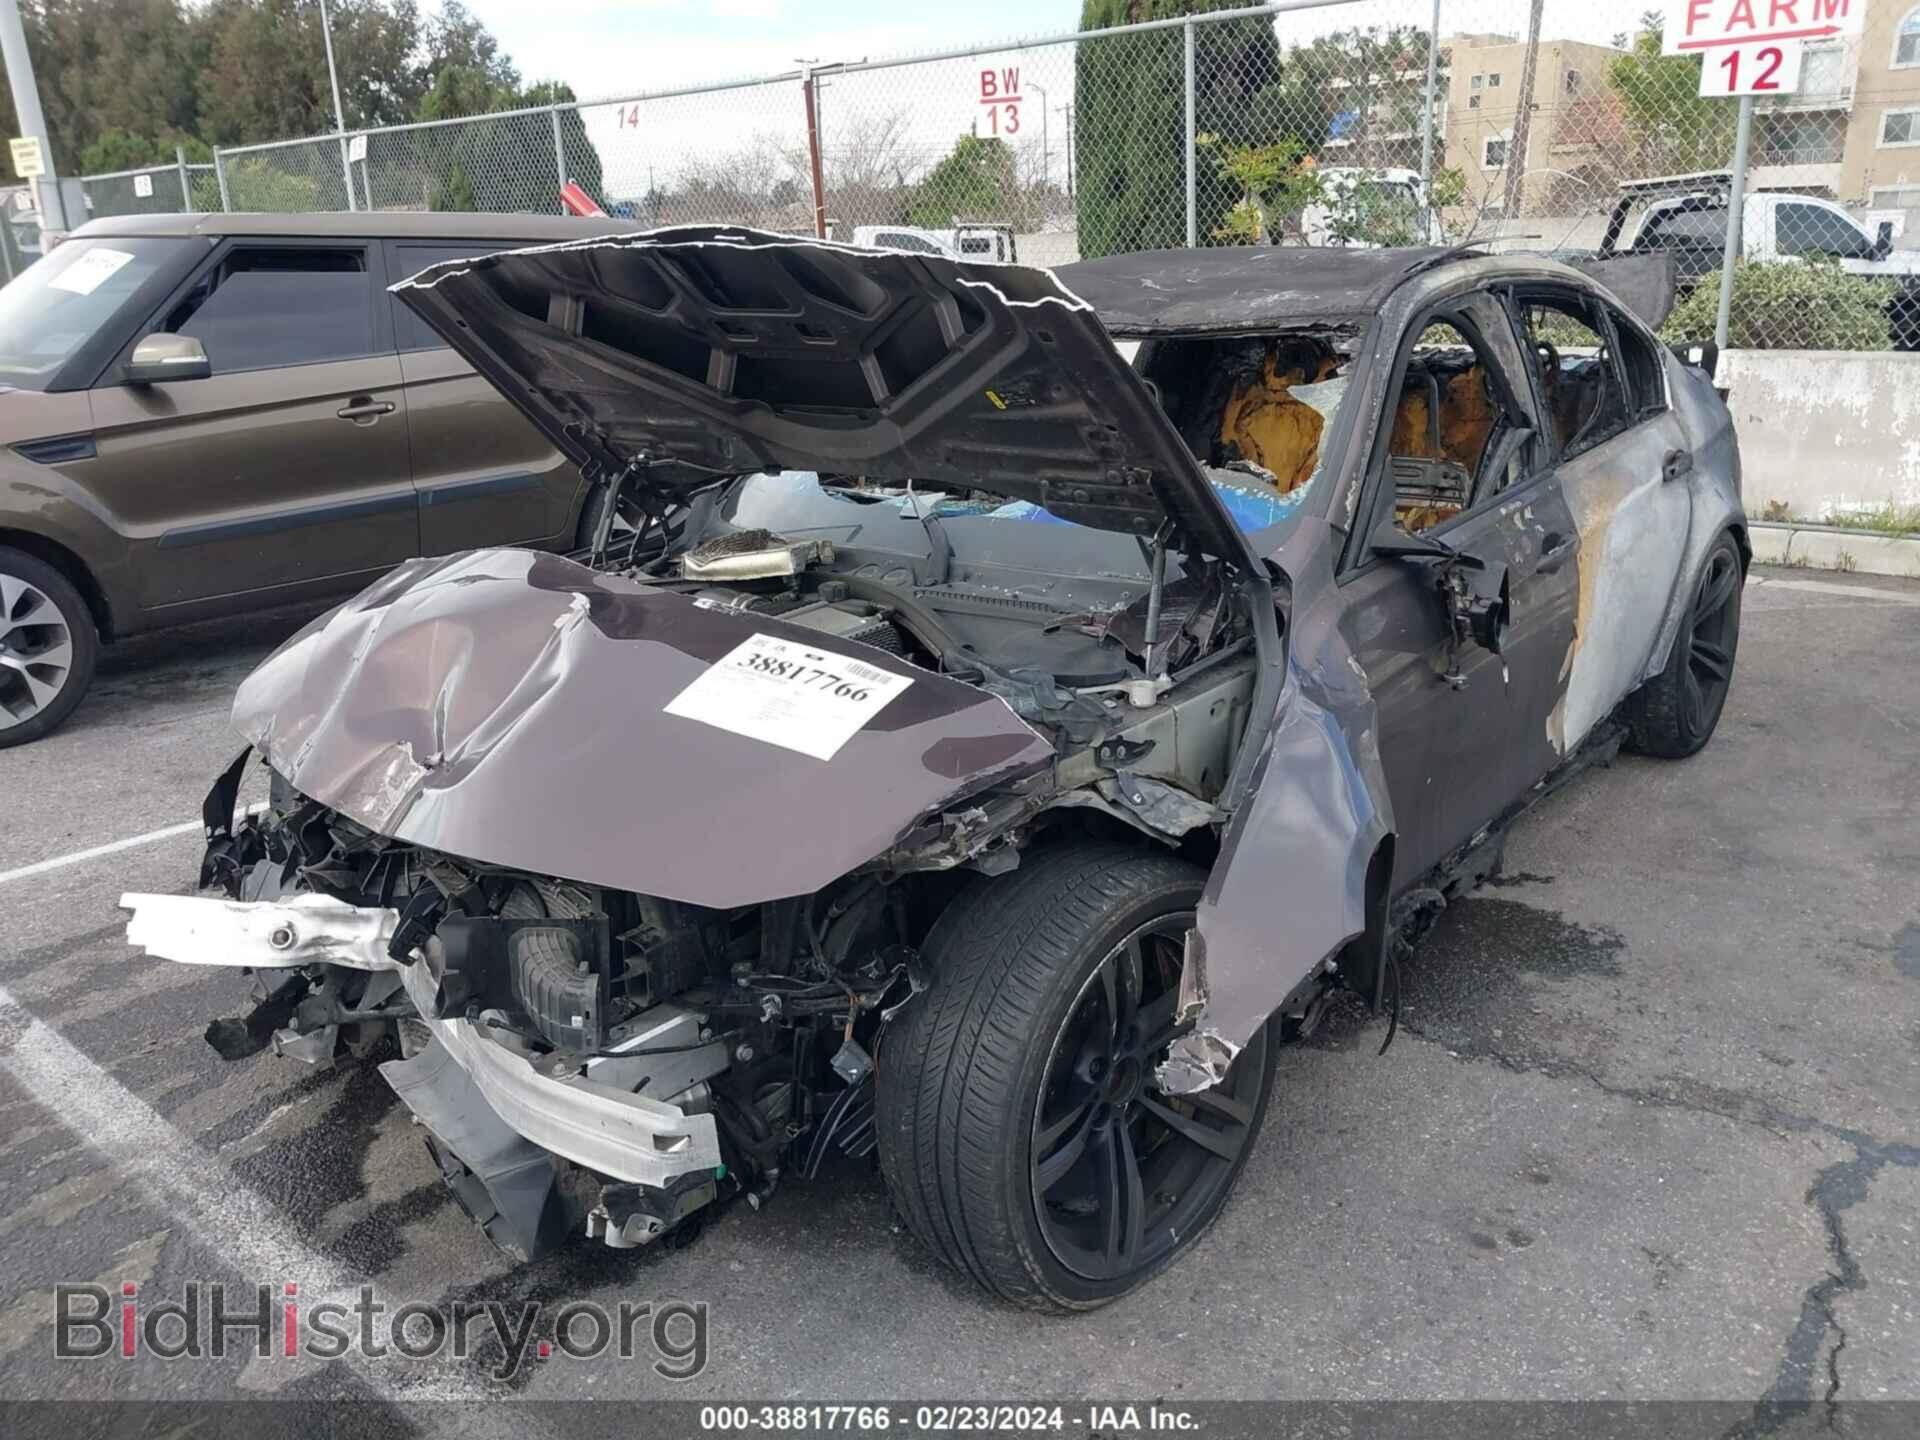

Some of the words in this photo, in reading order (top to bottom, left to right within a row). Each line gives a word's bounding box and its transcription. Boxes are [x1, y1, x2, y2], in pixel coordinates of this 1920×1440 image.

[1686, 0, 1850, 36] FARM
[980, 66, 1020, 97] BW
[1721, 47, 1783, 92] 12
[617, 104, 640, 129] 14
[987, 104, 1020, 135] 13
[737, 653, 876, 702] 38817766
